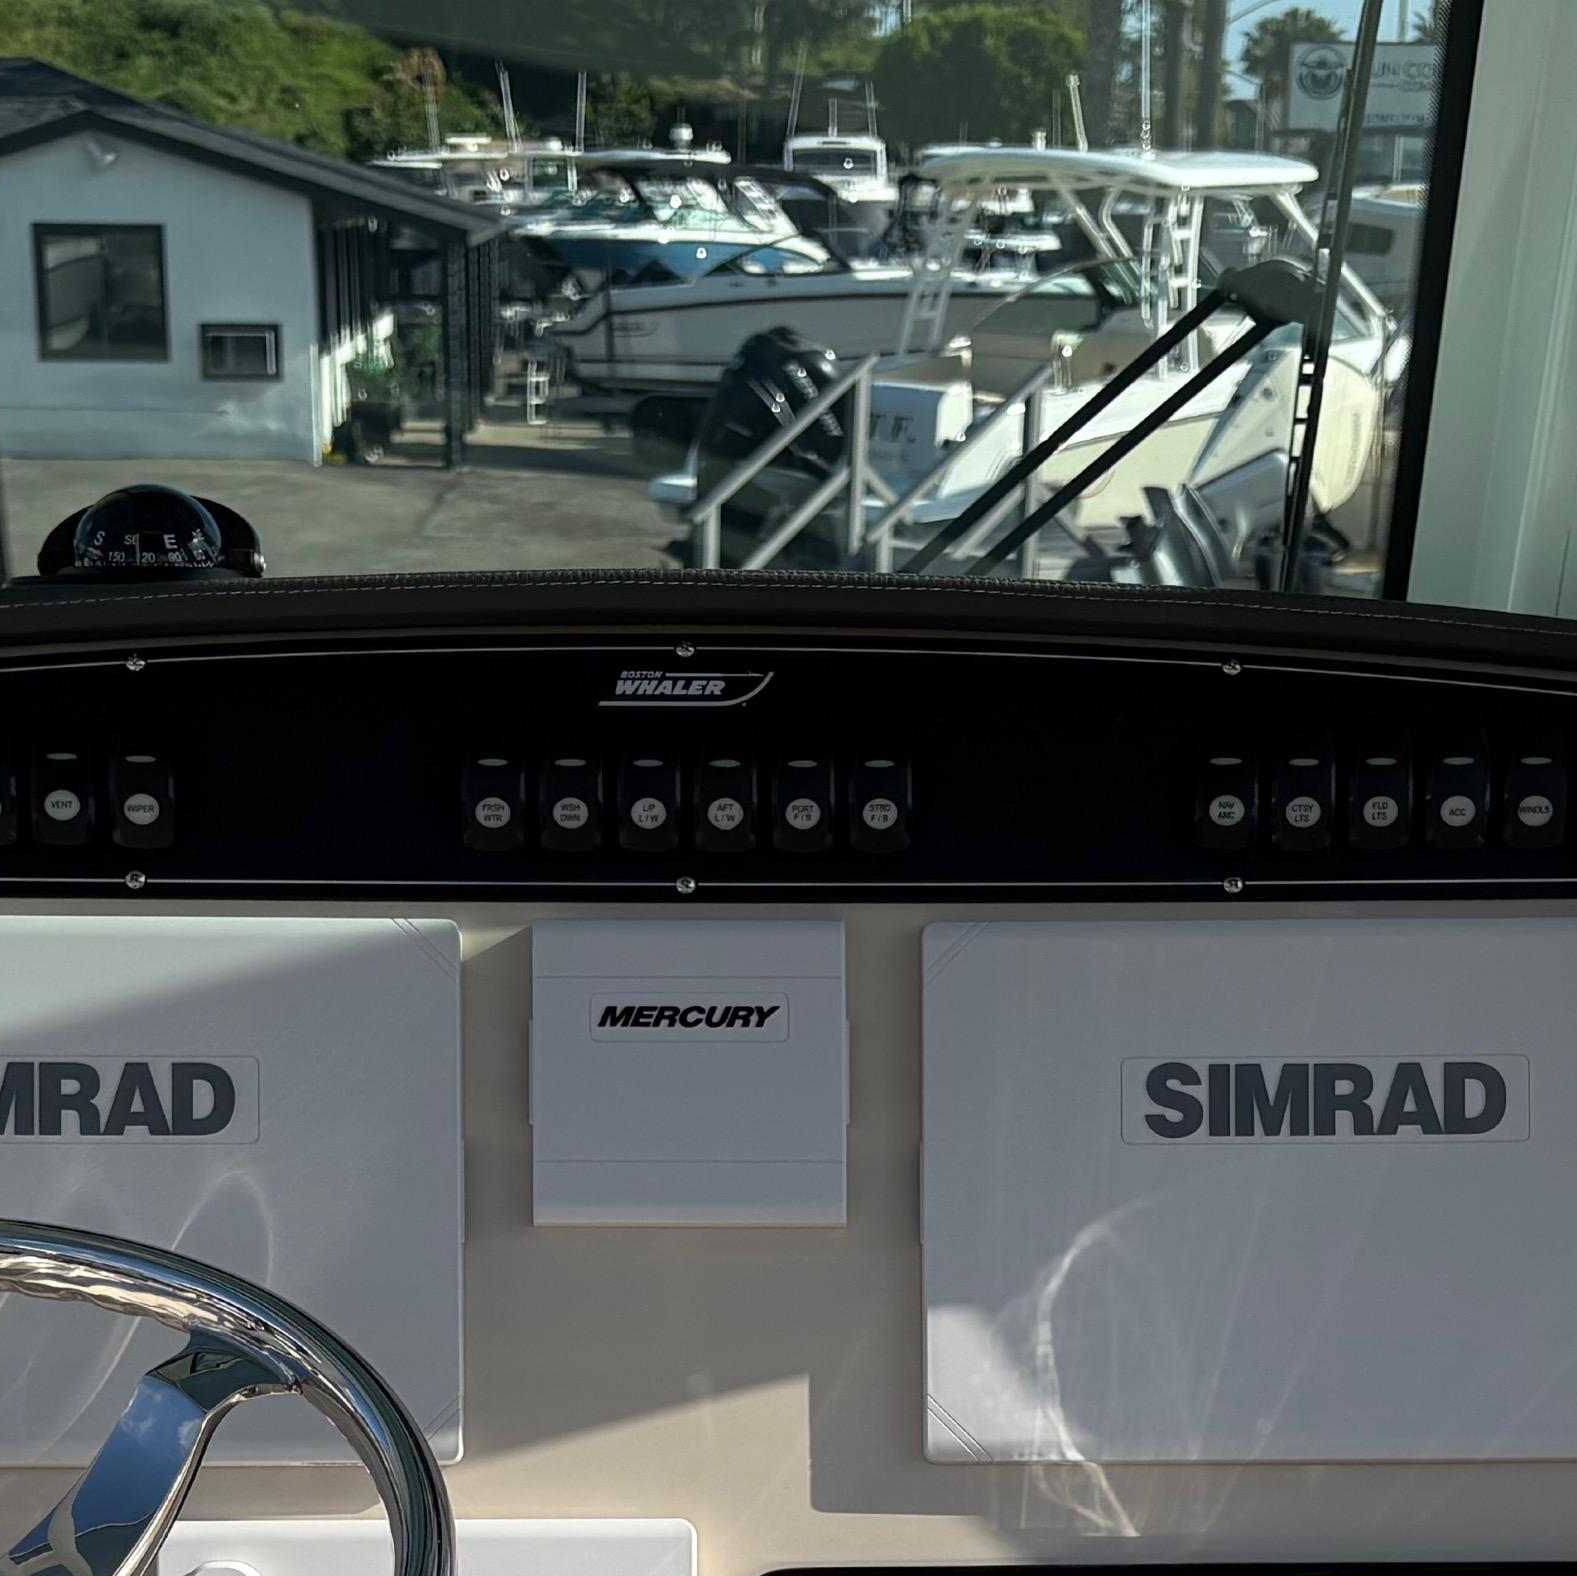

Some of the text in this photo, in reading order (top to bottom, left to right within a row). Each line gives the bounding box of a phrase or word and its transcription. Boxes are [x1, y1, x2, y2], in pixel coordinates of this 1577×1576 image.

[94, 530, 105, 546] S
[163, 534, 178, 549] E
[108, 551, 125, 562] 150
[615, 680, 725, 695] WHALER
[50, 801, 73, 809] VENT
[127, 804, 155, 813] WIPER
[717, 804, 734, 812] AFT
[792, 805, 814, 813] PORT
[1449, 808, 1466, 816] ACC
[484, 814, 503, 822] WTR
[597, 1005, 780, 1028] MERCURY
[1143, 1061, 1508, 1139] SIMRAD
